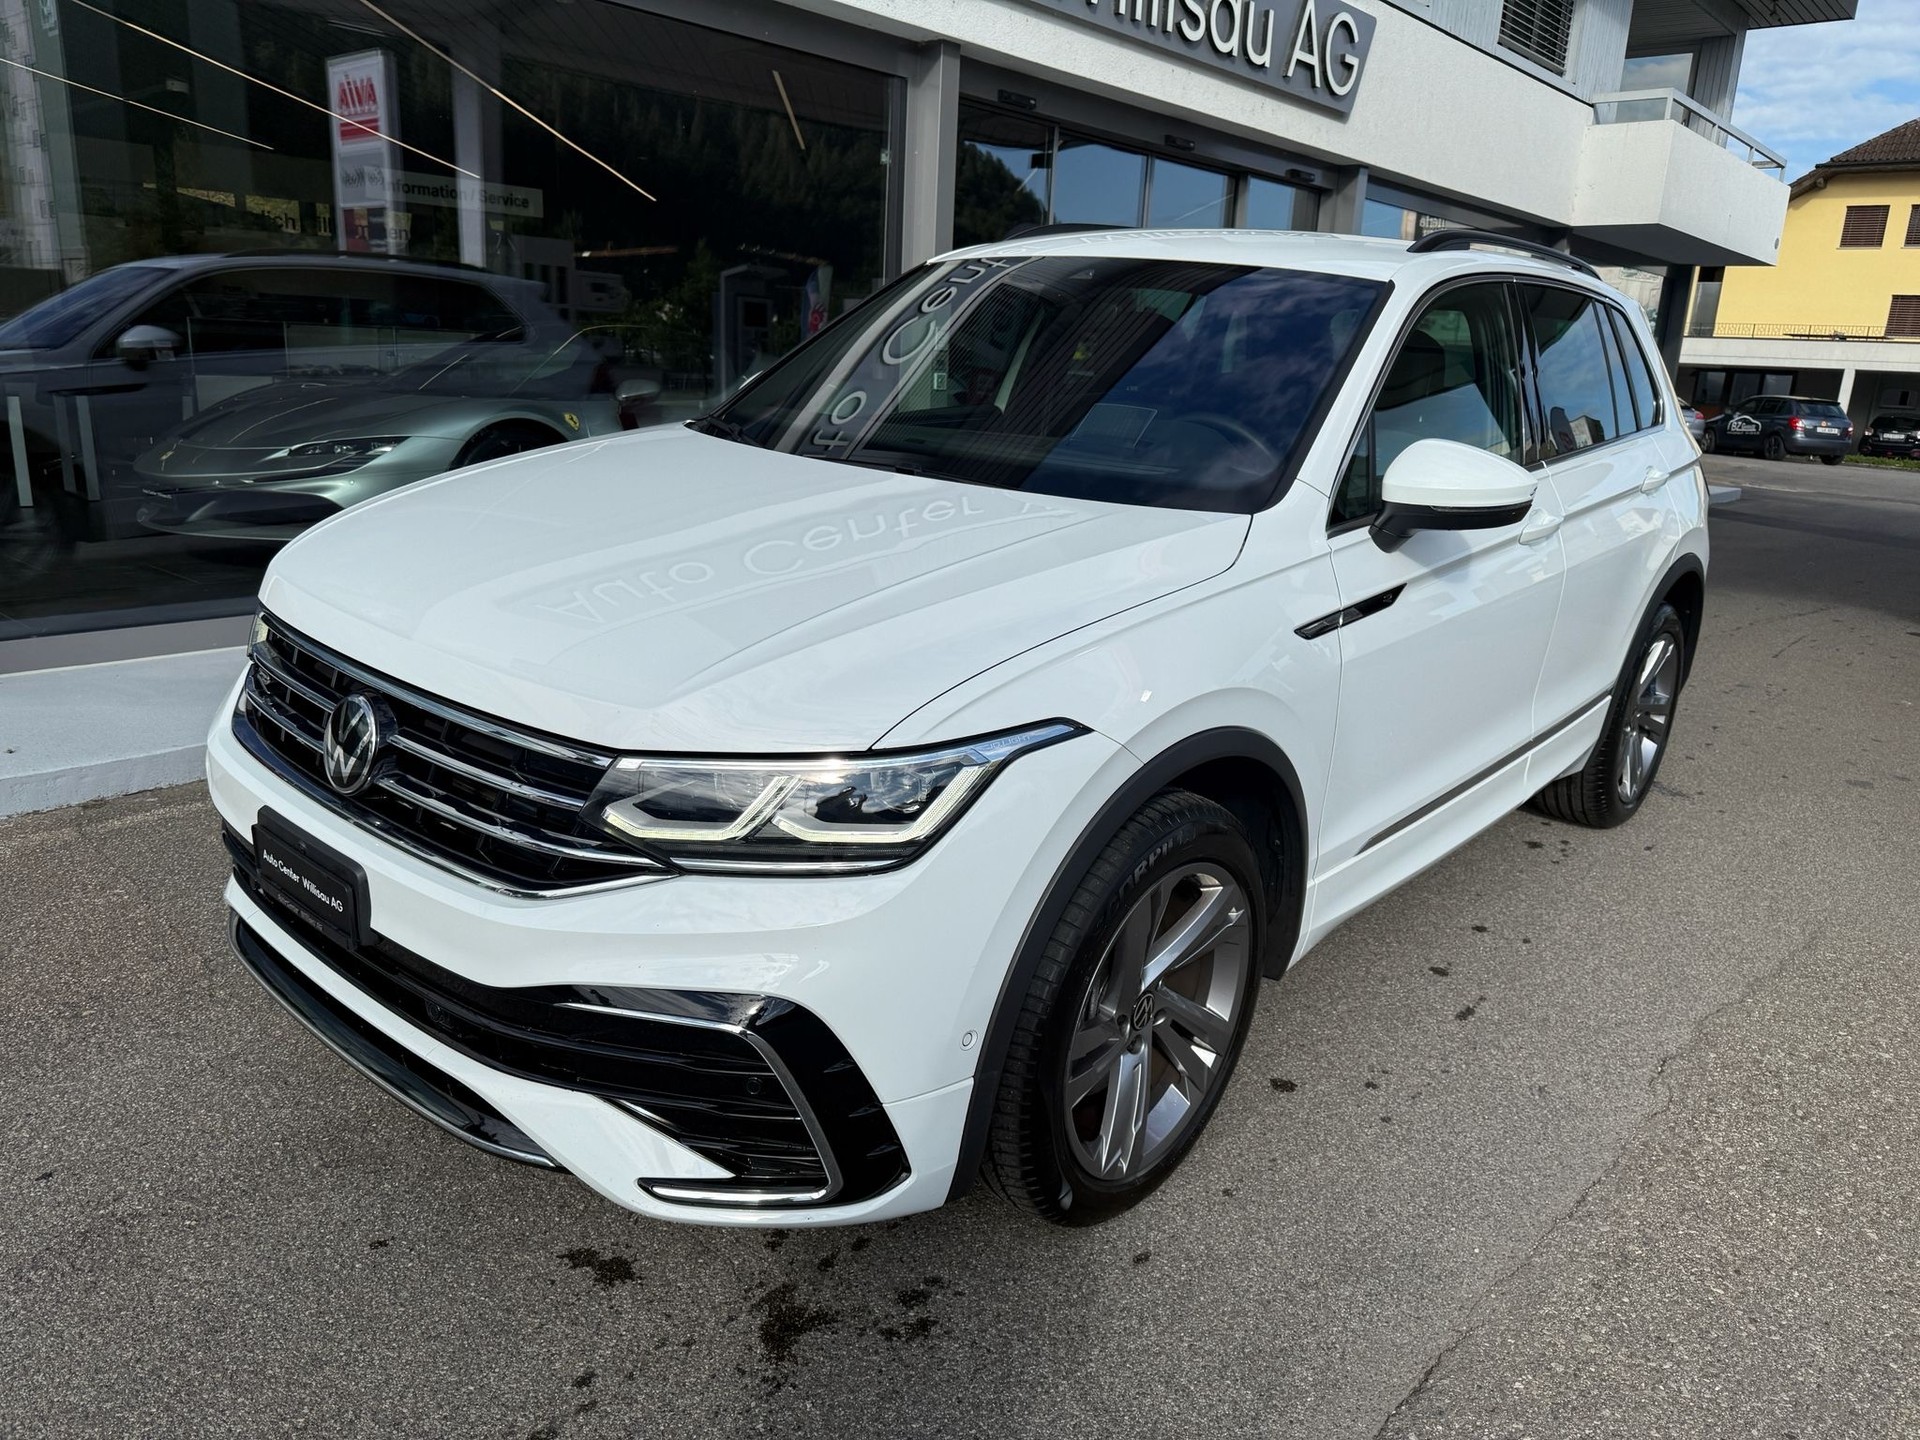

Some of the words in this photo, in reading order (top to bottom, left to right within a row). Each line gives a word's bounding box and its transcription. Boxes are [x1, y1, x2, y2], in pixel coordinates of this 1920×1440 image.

[1285, 0, 1360, 97] AG
[385, 178, 468, 202] nformation
[479, 189, 530, 209] Service
[263, 849, 278, 867] Auto
[278, 860, 300, 883] Center
[301, 876, 330, 905] Willisau
[331, 896, 344, 912] AG
